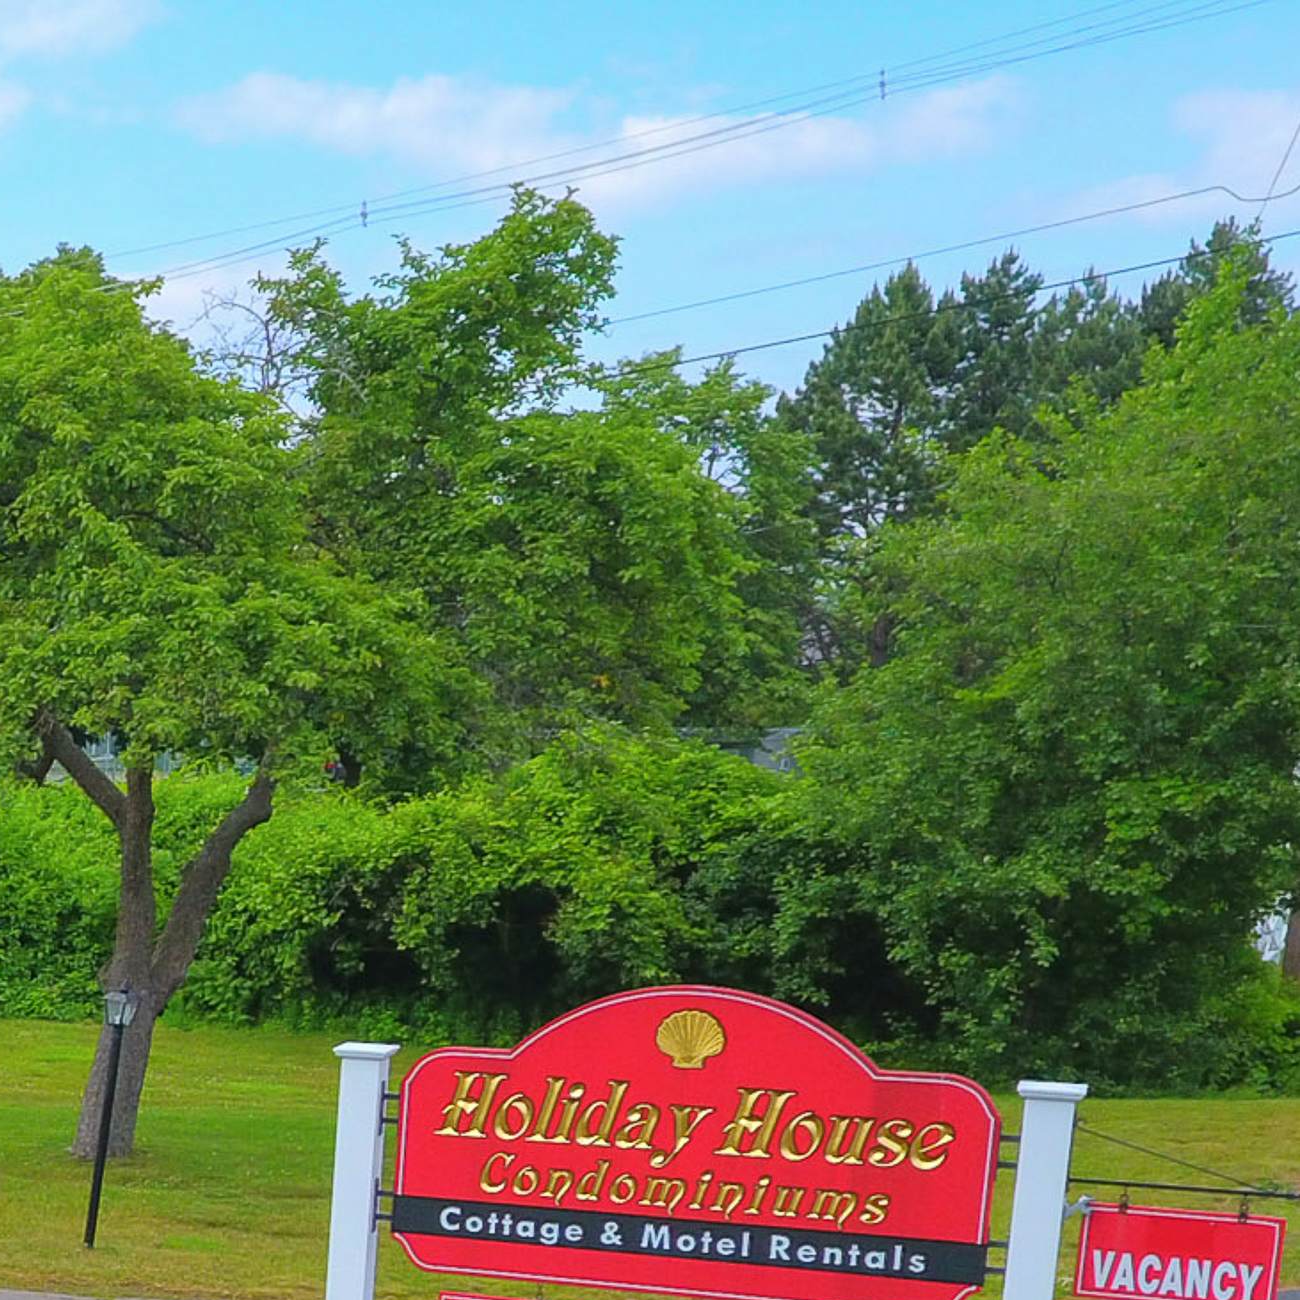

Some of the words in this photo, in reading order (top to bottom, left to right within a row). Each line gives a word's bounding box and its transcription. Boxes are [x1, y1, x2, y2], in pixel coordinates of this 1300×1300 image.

[432, 1070, 716, 1169] Holiday
[712, 1086, 957, 1171] House
[479, 1151, 892, 1231] Condominiums
[438, 1206, 584, 1246] Cottage
[599, 1220, 623, 1246] &
[640, 1223, 751, 1258] Motel
[768, 1233, 928, 1274] Rentals
